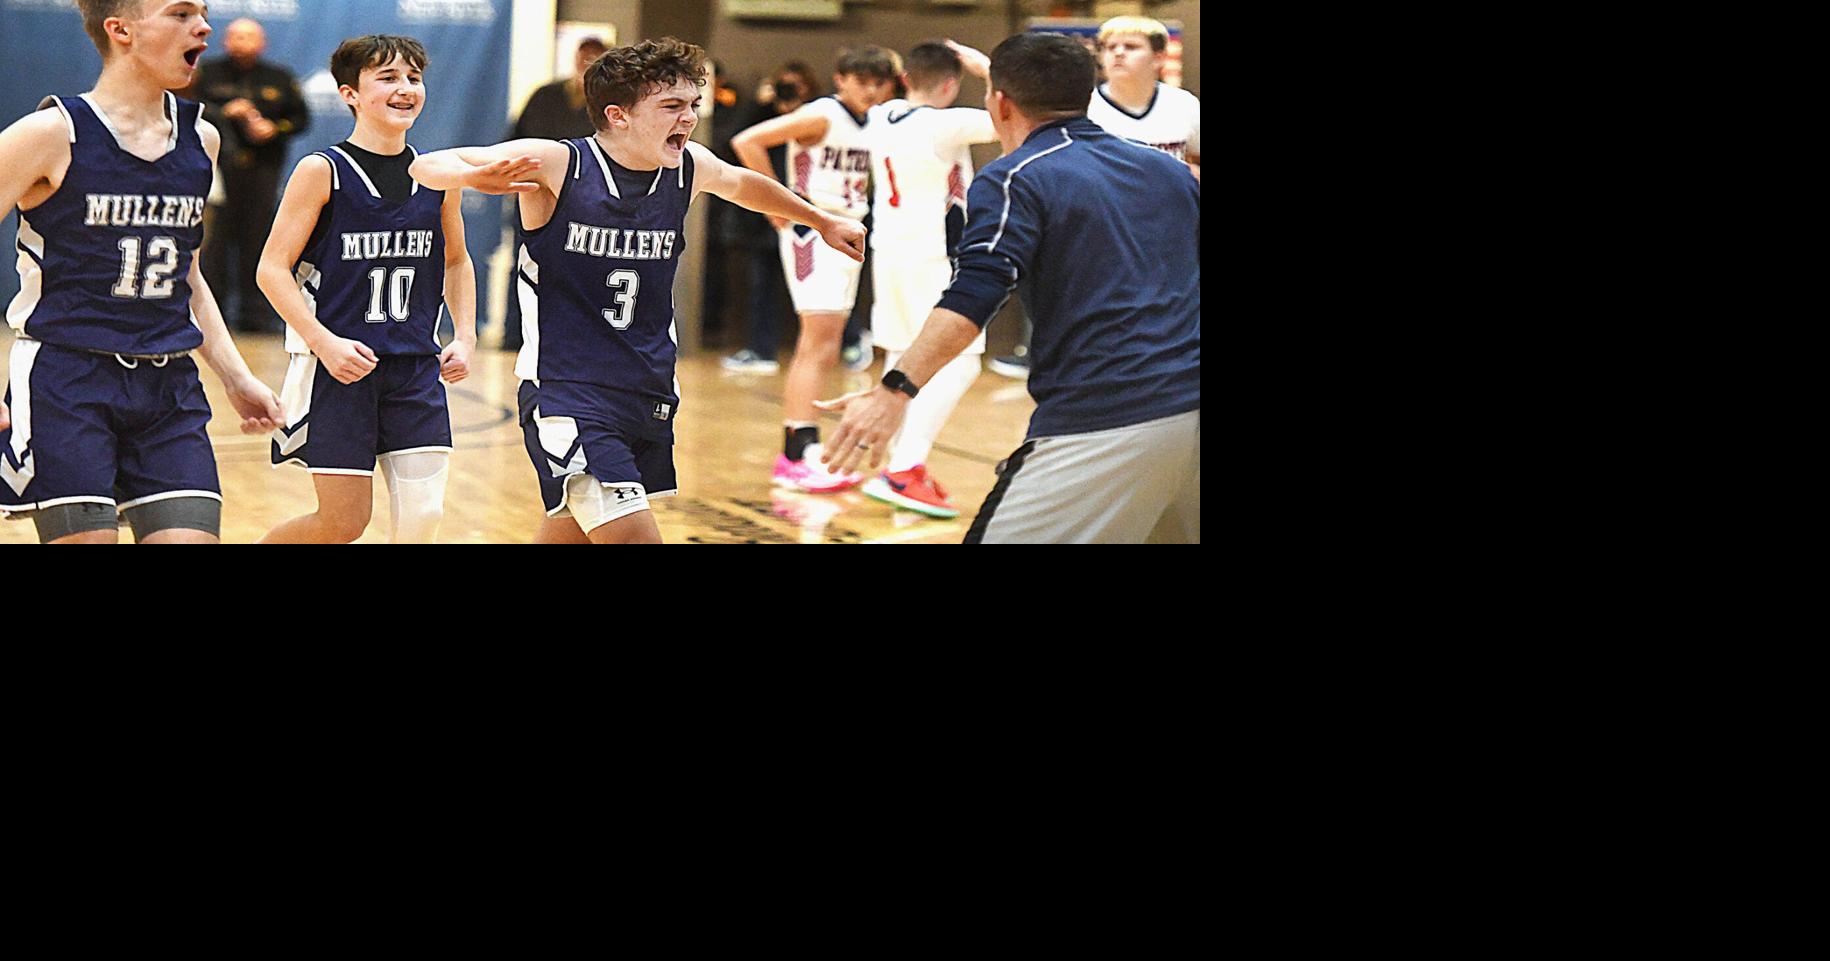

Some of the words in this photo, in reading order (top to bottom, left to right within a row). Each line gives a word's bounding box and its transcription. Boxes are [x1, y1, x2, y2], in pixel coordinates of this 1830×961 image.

[84, 193, 205, 228] MULLENS
[341, 229, 433, 261] MULLENS
[565, 221, 677, 260] MULLENS
[111, 236, 179, 299] 12
[365, 266, 416, 323] 10
[602, 268, 641, 331] 3
